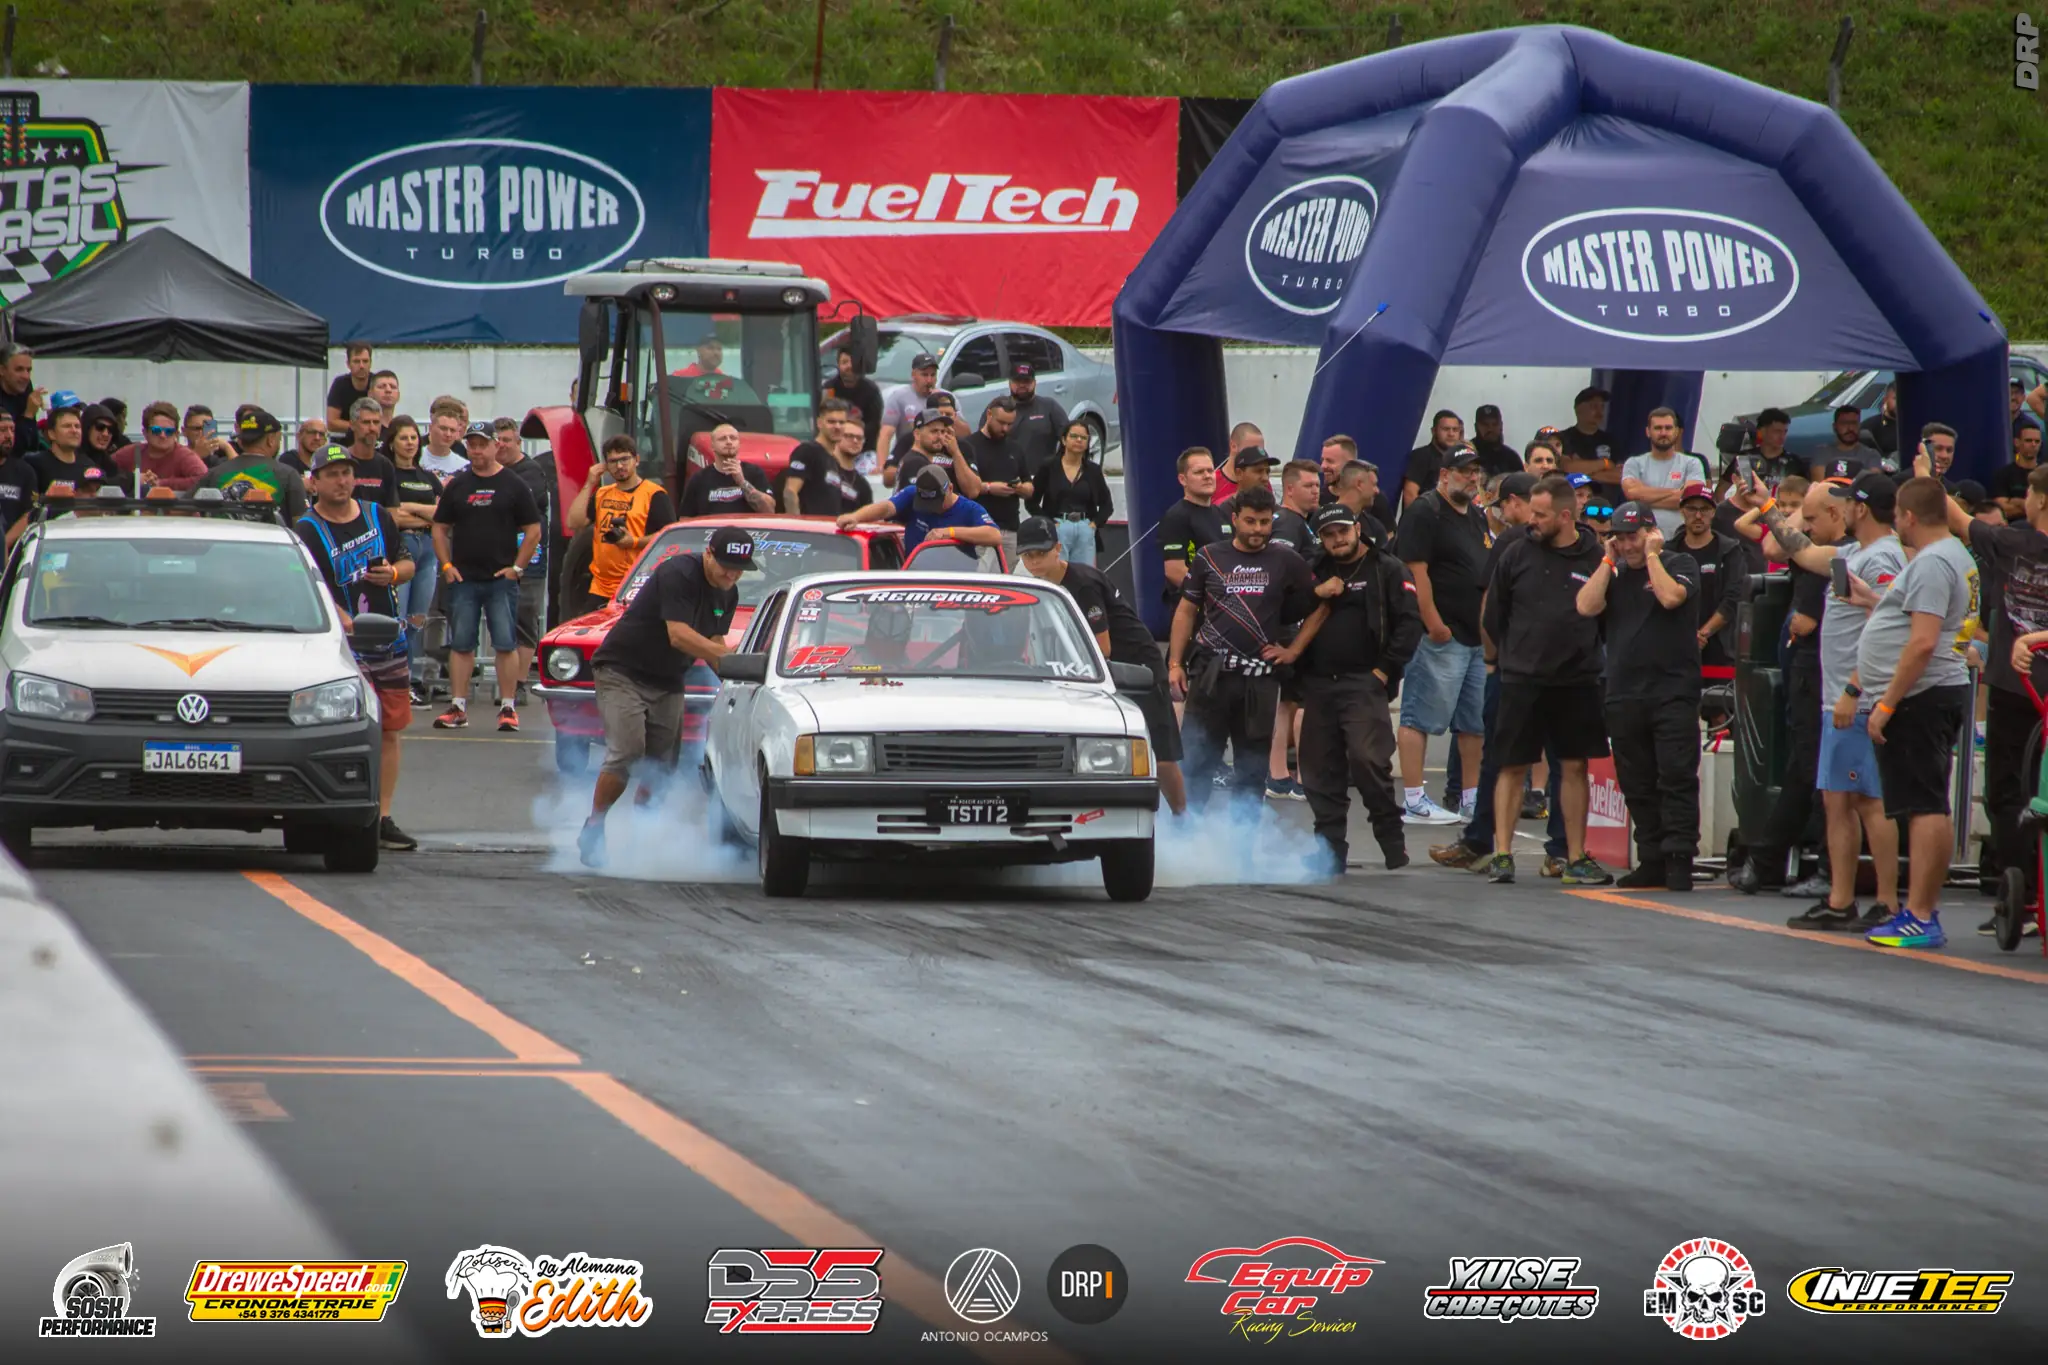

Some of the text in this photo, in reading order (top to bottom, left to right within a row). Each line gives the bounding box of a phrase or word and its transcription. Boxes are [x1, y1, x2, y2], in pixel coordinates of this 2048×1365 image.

[0, 161, 118, 209] TAS
[346, 166, 619, 234] MASTER POWER
[748, 169, 1139, 239] FuelTech
[0, 203, 118, 251] ASIL
[1260, 197, 1337, 263] MASTER
[406, 248, 562, 260] TURBO
[1542, 230, 1775, 292] MASTER POWER
[1281, 274, 1342, 290] TURBO
[1597, 305, 1731, 316] TURBO
[726, 542, 751, 554] 1517
[152, 752, 230, 770] JAL6G41
